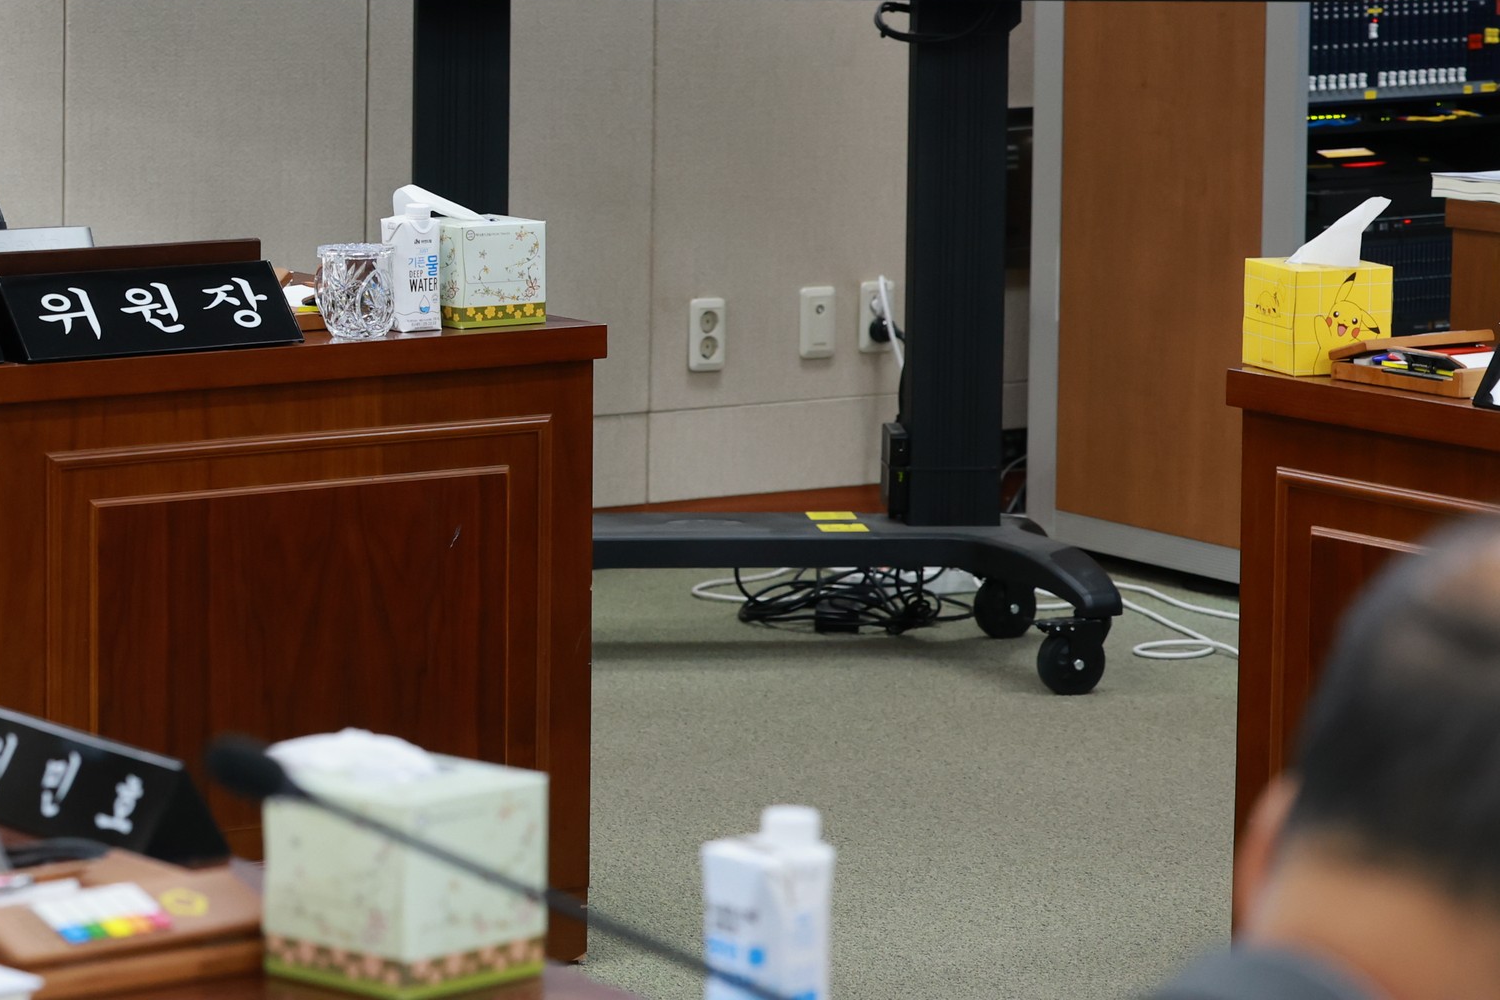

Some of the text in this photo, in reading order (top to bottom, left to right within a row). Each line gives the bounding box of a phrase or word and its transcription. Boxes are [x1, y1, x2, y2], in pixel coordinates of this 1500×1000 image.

[408, 270, 424, 279] DEEP
[409, 277, 438, 292] WATER
[38, 277, 268, 340] 위원장
